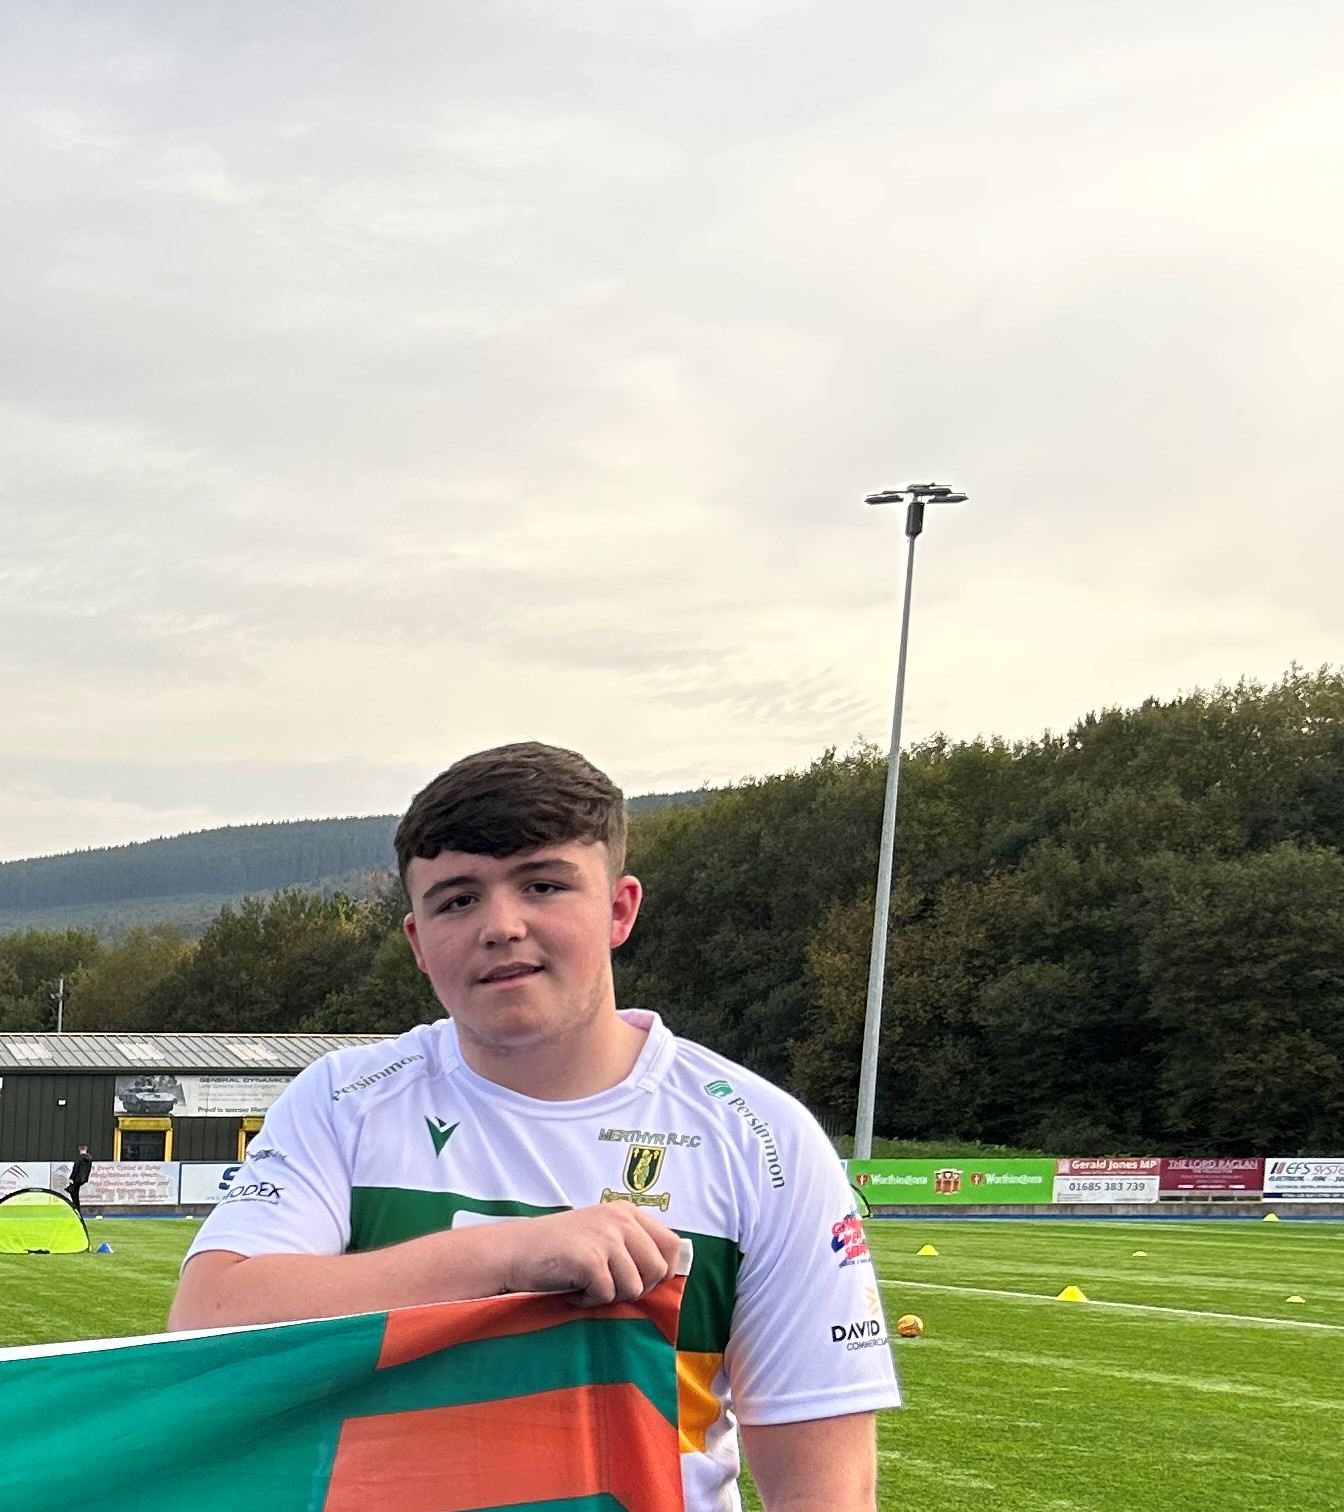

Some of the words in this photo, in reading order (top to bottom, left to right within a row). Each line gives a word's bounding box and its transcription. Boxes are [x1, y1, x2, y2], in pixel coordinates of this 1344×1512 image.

[332, 1054, 425, 1101] Persimmon
[598, 1128, 666, 1145] MERTHYR
[728, 1096, 786, 1189] Persimmon
[1072, 1159, 1106, 1169] Gerald
[1107, 1159, 1138, 1171] Jones
[1140, 1159, 1158, 1169] MP
[1168, 1159, 1188, 1170] THE
[1286, 1162, 1310, 1175] EFS
[1069, 1182, 1101, 1192] 01685
[1126, 1182, 1145, 1191] 739
[830, 1319, 880, 1343] DAVID
